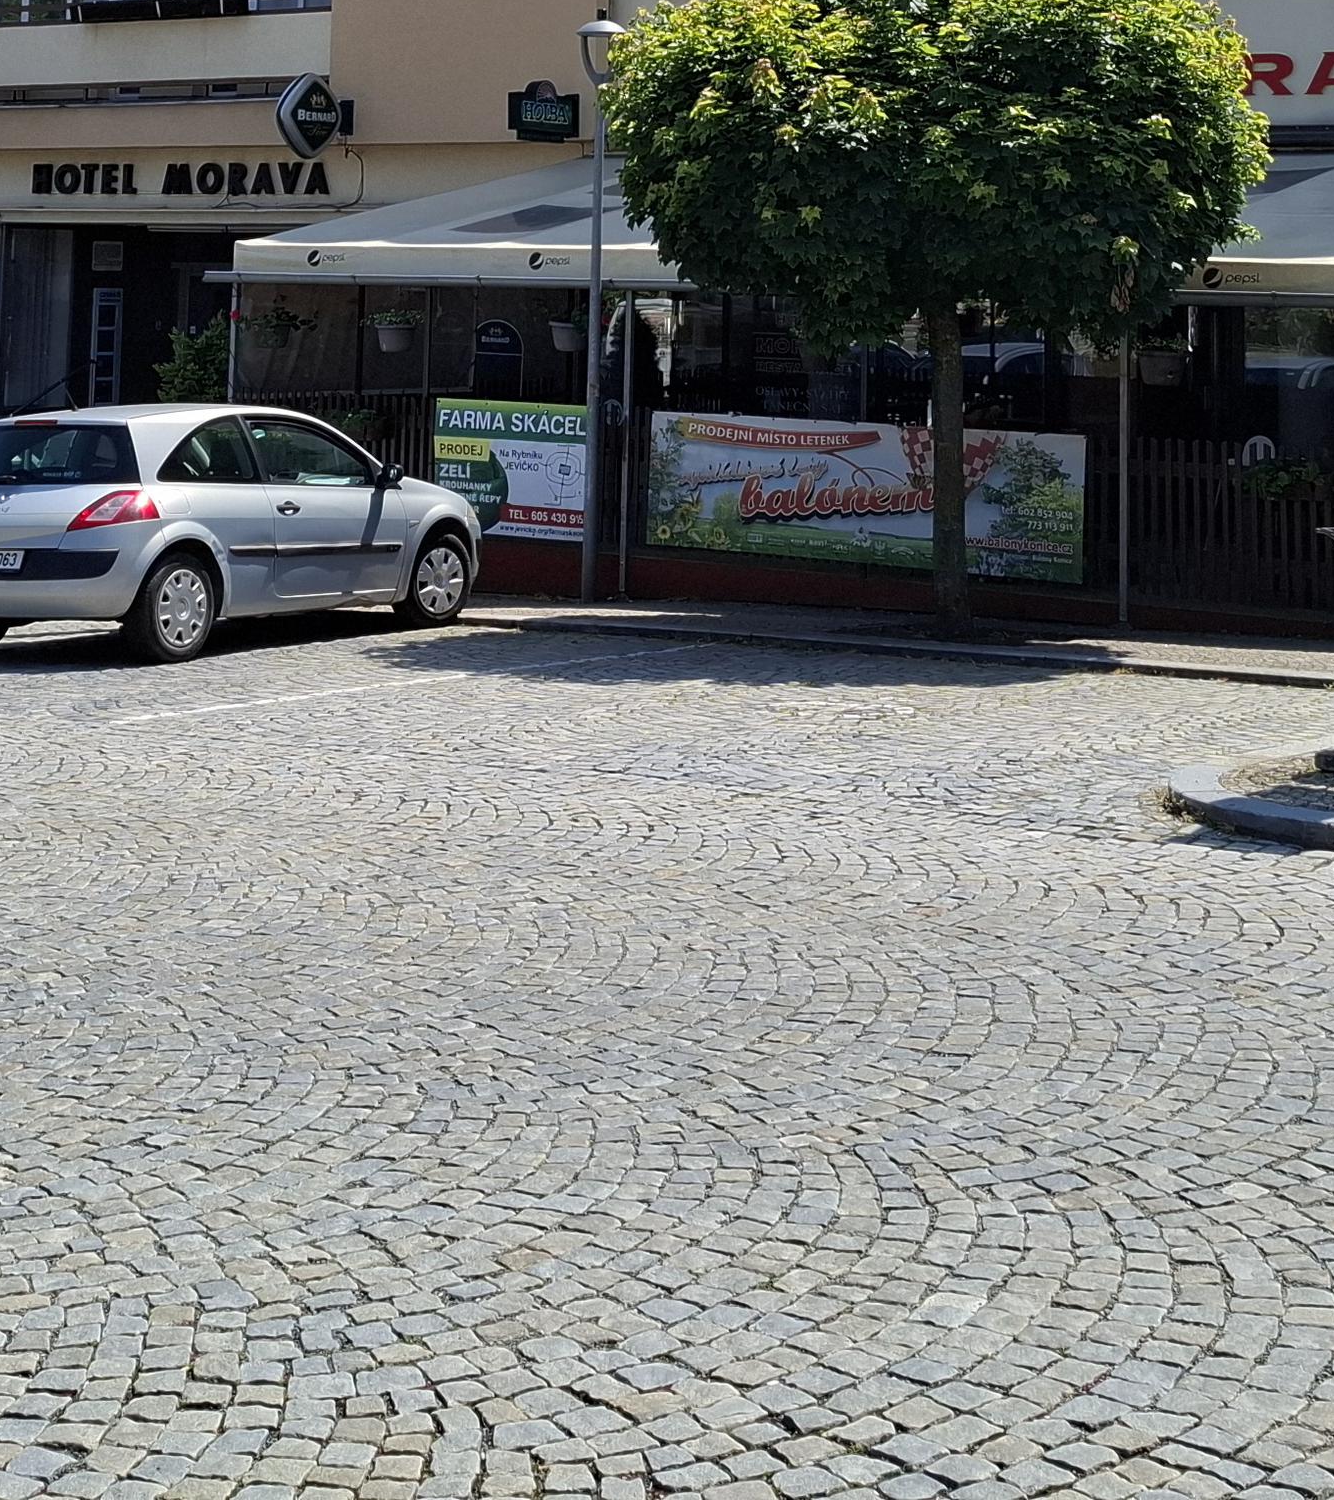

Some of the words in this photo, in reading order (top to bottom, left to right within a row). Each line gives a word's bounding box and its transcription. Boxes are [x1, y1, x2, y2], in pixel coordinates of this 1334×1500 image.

[297, 108, 337, 124] BERNARD
[523, 100, 569, 125] HOLBA
[32, 163, 138, 195] HOTEL
[162, 162, 330, 196] MORAVA
[321, 252, 346, 263] pepsi
[544, 256, 570, 266] pepsi
[1225, 272, 1260, 285] pepsi
[439, 409, 505, 431] FARMA
[511, 410, 586, 436] SKÁCEL
[688, 421, 753, 442] PRODEJNÍ
[757, 430, 796, 445] MÍSTO
[801, 434, 850, 446] LETENEK
[439, 443, 484, 456] PRODEJ
[499, 449, 509, 458] Na
[512, 449, 543, 461] Rybníku
[439, 463, 471, 479] ZELÍ
[504, 460, 540, 472] JEVÍČKO
[439, 481, 492, 491] KROUHANKY
[479, 492, 501, 504] ŘEPY
[740, 472, 935, 521] balónem
[509, 509, 529, 521] TEL:
[531, 511, 548, 522] 605
[551, 512, 567, 523] 430
[569, 514, 584, 525] 915
[1018, 507, 1035, 517] 602
[1037, 508, 1052, 519] 852
[1056, 510, 1073, 520] 904
[1027, 521, 1042, 530] 773
[1045, 521, 1057, 531] 113
[1059, 522, 1073, 532] 911
[965, 536, 1074, 555] ww.balonykonice.cz
